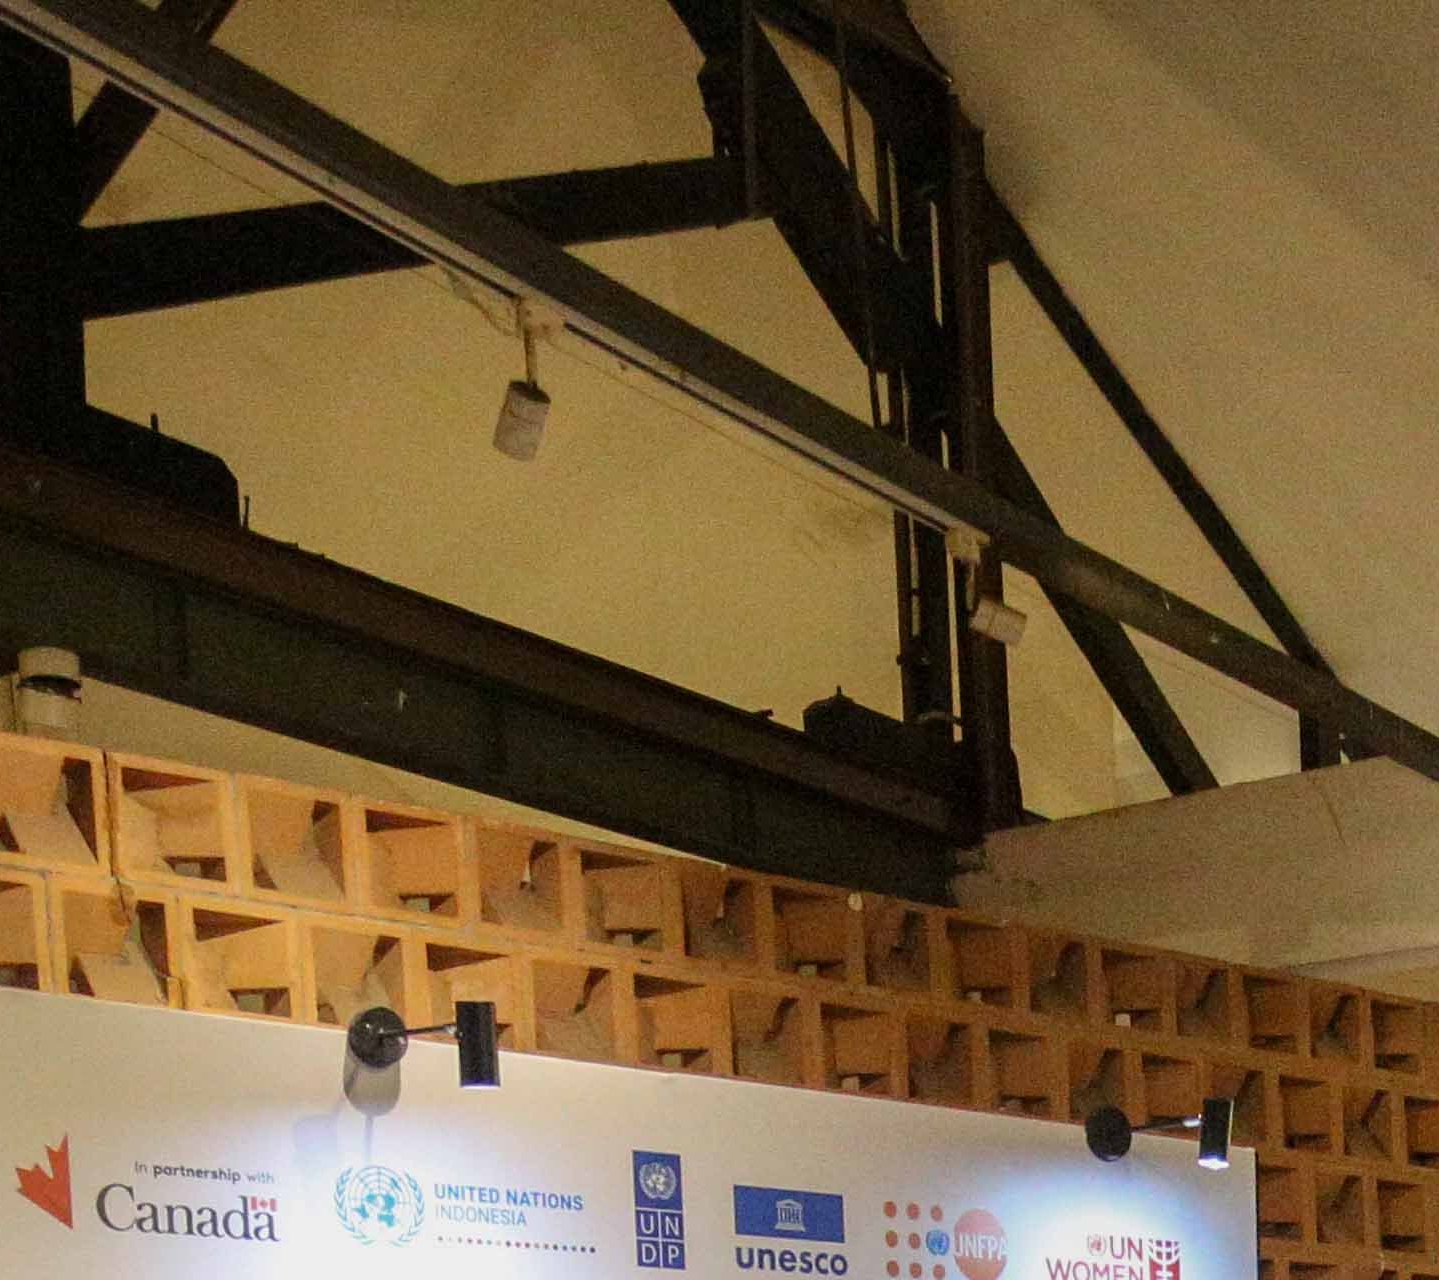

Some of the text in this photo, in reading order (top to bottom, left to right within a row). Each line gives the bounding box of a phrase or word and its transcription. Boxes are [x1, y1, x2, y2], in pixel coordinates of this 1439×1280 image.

[153, 1164, 241, 1184] partnership
[247, 1172, 275, 1184] with
[433, 1183, 584, 1211] UNITED NATIONS
[96, 1183, 281, 1242] Canada
[434, 1205, 528, 1227] INDONESIA
[954, 1231, 1008, 1262] UNFPA
[1109, 1235, 1144, 1259] UN
[734, 1246, 849, 1276] unesco
